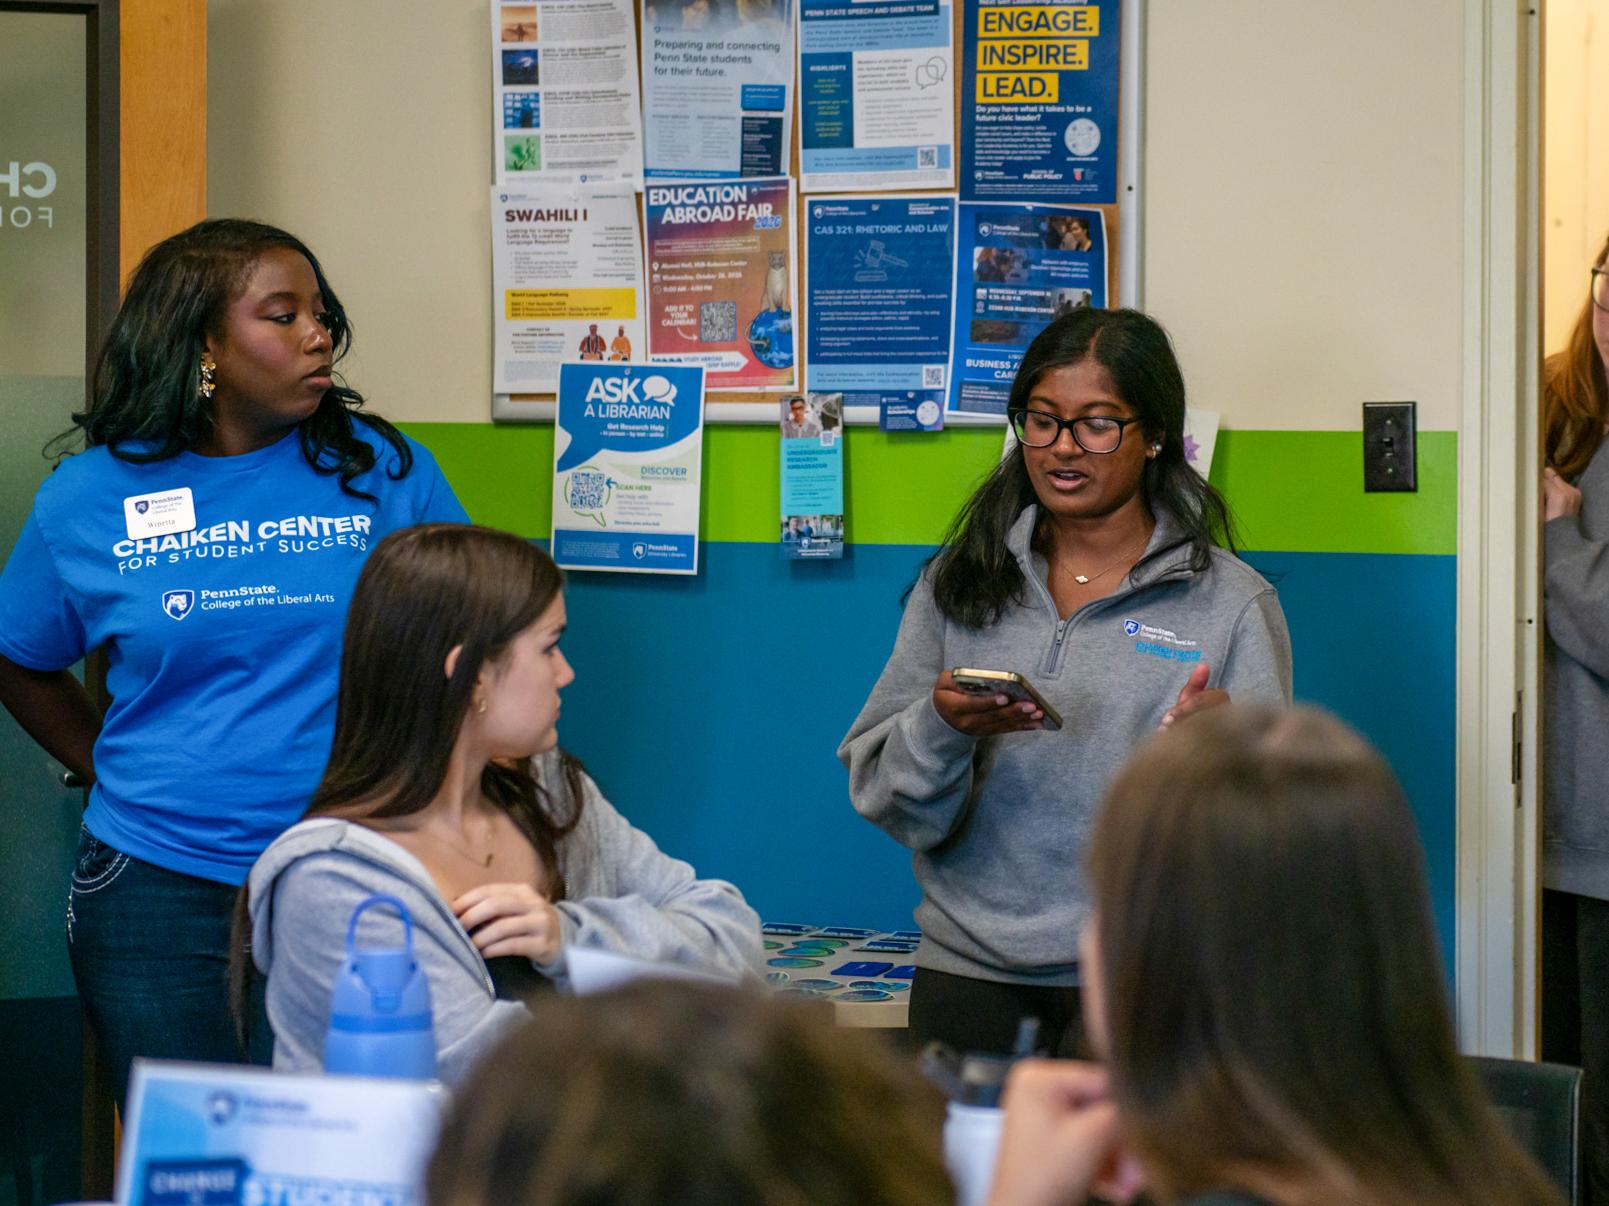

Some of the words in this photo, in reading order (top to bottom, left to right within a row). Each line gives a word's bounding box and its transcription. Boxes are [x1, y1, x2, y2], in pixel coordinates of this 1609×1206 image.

[983, 10, 1093, 32] ENGAGE.
[654, 40, 703, 52] Preparing
[706, 42, 724, 50] and
[726, 42, 781, 53] connecting
[654, 52, 680, 62] Penn
[682, 53, 708, 62] State
[710, 54, 752, 64] students
[983, 44, 1083, 65] INSPIRE.
[654, 66, 668, 76] for
[670, 66, 692, 76] their
[696, 67, 727, 77] future.
[982, 76, 1052, 98] LEAD.
[988, 106, 1000, 114] you
[648, 185, 747, 206] EDUCATION
[505, 209, 578, 222] SWAHILI
[583, 208, 588, 221] I
[661, 204, 736, 224] ABROAD
[738, 203, 774, 221] FAIR
[814, 226, 834, 234] CAS
[836, 225, 854, 234] 321:
[856, 224, 902, 234] RHETORIC
[904, 224, 925, 233] AND
[927, 224, 948, 233] LAW
[966, 359, 1011, 369] BUSINESS
[585, 377, 640, 404] ASK
[584, 403, 595, 418] A
[598, 404, 671, 420] LIBRARIAN
[650, 424, 664, 432] Help
[641, 466, 687, 476] DISCOVER
[151, 495, 183, 504] PennState
[112, 520, 250, 558] CHAIKEN
[258, 514, 372, 540] CENTER
[118, 556, 157, 576] FOR
[168, 540, 267, 564] STUDENT
[278, 533, 367, 554] SUCCESS
[201, 600, 241, 610] College
[244, 597, 254, 606] of
[258, 596, 274, 605] the
[278, 594, 312, 604] Liberal
[315, 594, 335, 603] Arts
